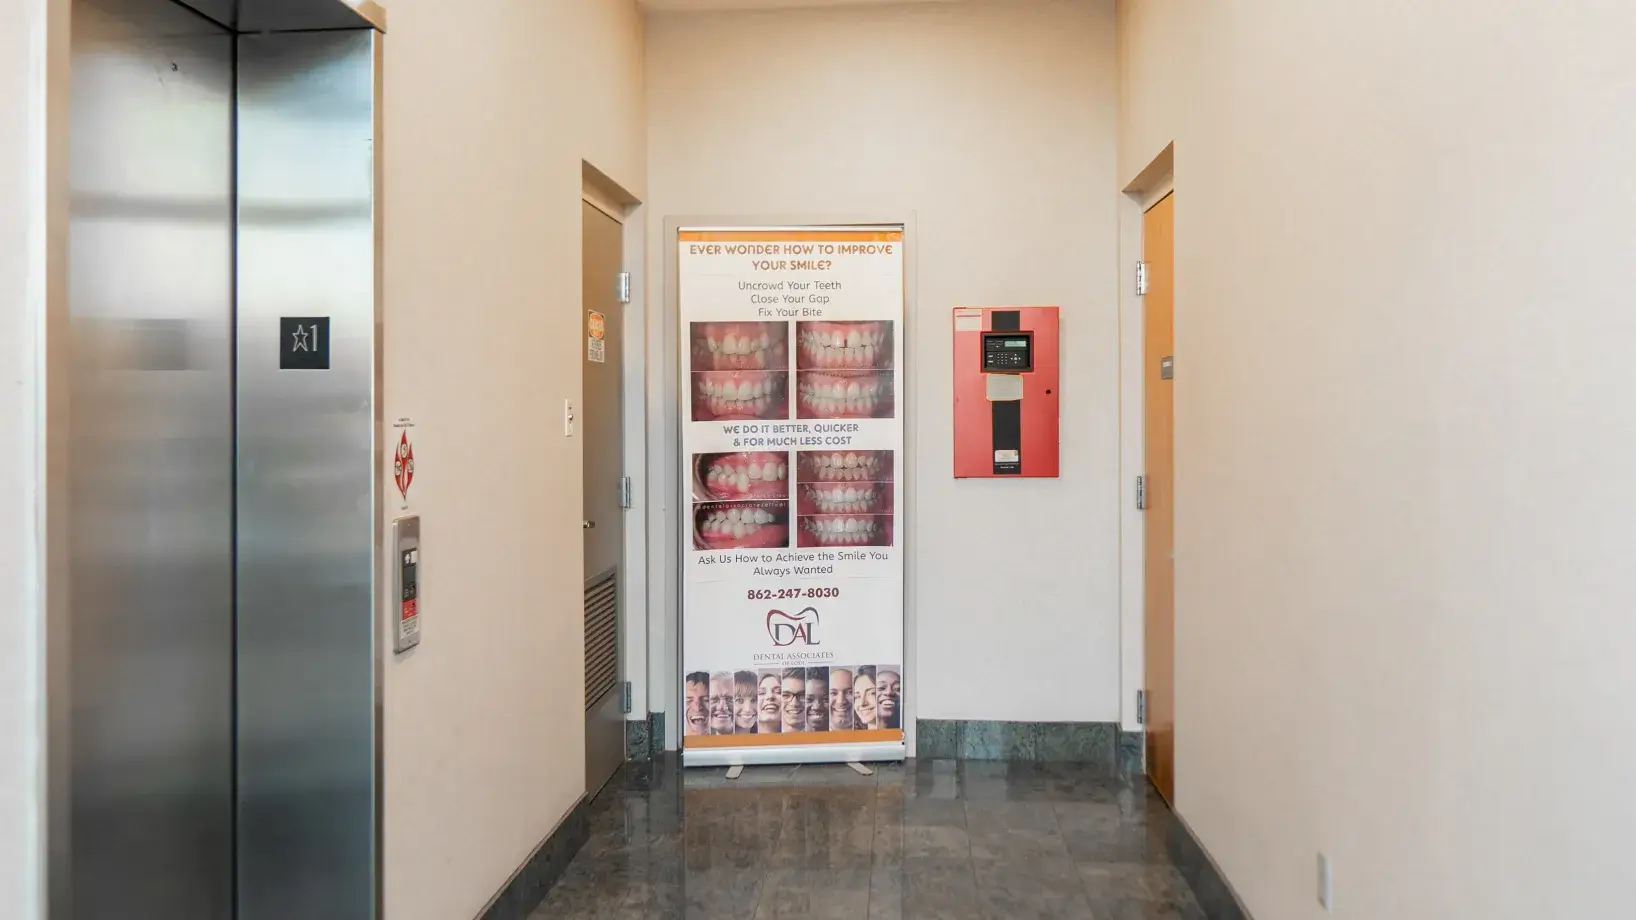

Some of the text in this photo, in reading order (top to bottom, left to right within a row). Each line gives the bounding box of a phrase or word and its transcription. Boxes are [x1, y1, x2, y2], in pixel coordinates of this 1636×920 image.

[784, 244, 813, 254] HOW
[818, 244, 834, 254] TO
[838, 244, 892, 254] IMPROVE
[752, 260, 832, 270] YOUR SMILE?
[738, 280, 842, 290] Uncrowd Your Teeth
[750, 294, 830, 306] Close Your Gap
[758, 308, 822, 317] Fix Your Bite
[723, 424, 859, 435] WE DO IT BETTER, QUICKER
[734, 436, 852, 446] & FOR MUCH LESS COST
[698, 552, 888, 564] Ask Us How to Achieve the Smile You
[753, 566, 832, 577] Always Wanted
[748, 588, 839, 600] 862-247-8030
[772, 622, 820, 646] DAL
